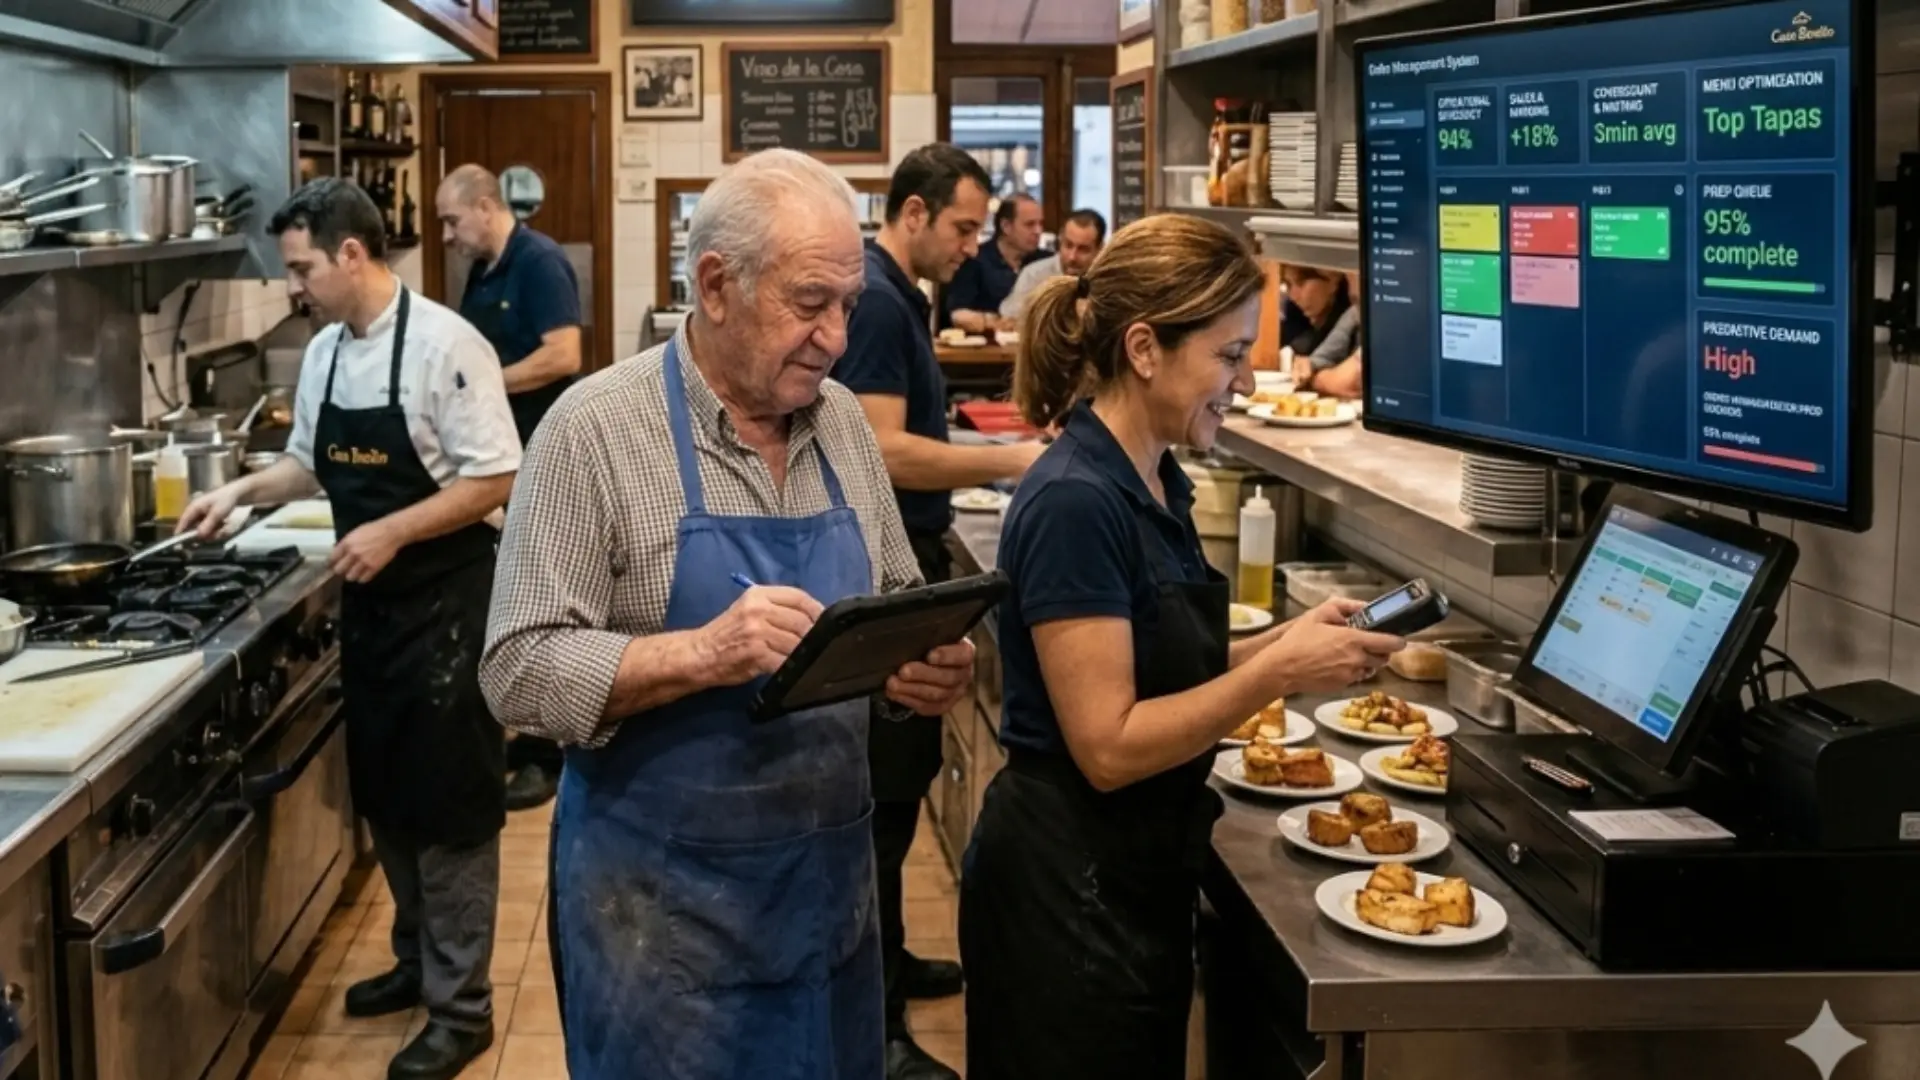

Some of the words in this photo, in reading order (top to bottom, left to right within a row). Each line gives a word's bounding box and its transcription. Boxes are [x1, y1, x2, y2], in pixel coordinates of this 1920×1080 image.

[781, 57, 801, 77] de
[1703, 107, 1745, 138] Top
[1750, 104, 1822, 137] Tapas
[1438, 128, 1473, 150] 94%
[1510, 123, 1559, 147] +18%
[1643, 123, 1677, 146] avg
[1703, 184, 1732, 198] PREP
[1703, 208, 1751, 236] 95%
[1703, 240, 1799, 270] complete
[1703, 345, 1755, 379] High
